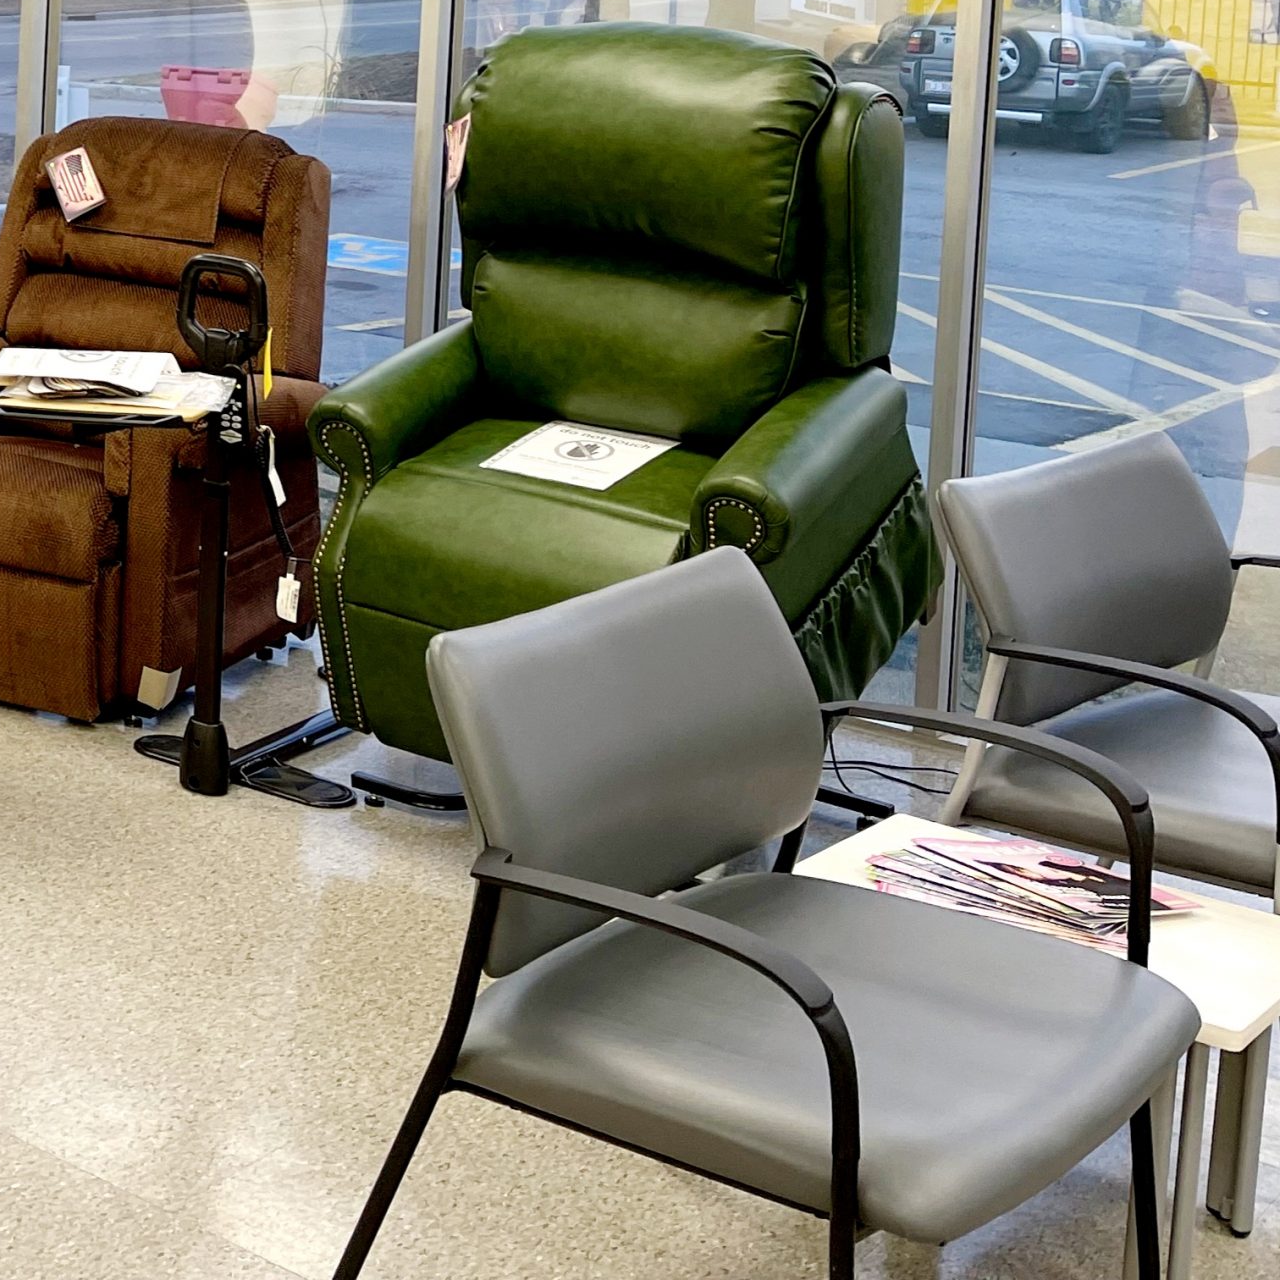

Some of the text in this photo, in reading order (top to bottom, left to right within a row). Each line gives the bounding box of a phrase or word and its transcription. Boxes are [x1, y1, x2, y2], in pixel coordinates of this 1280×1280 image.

[560, 428, 651, 451] do not touch
